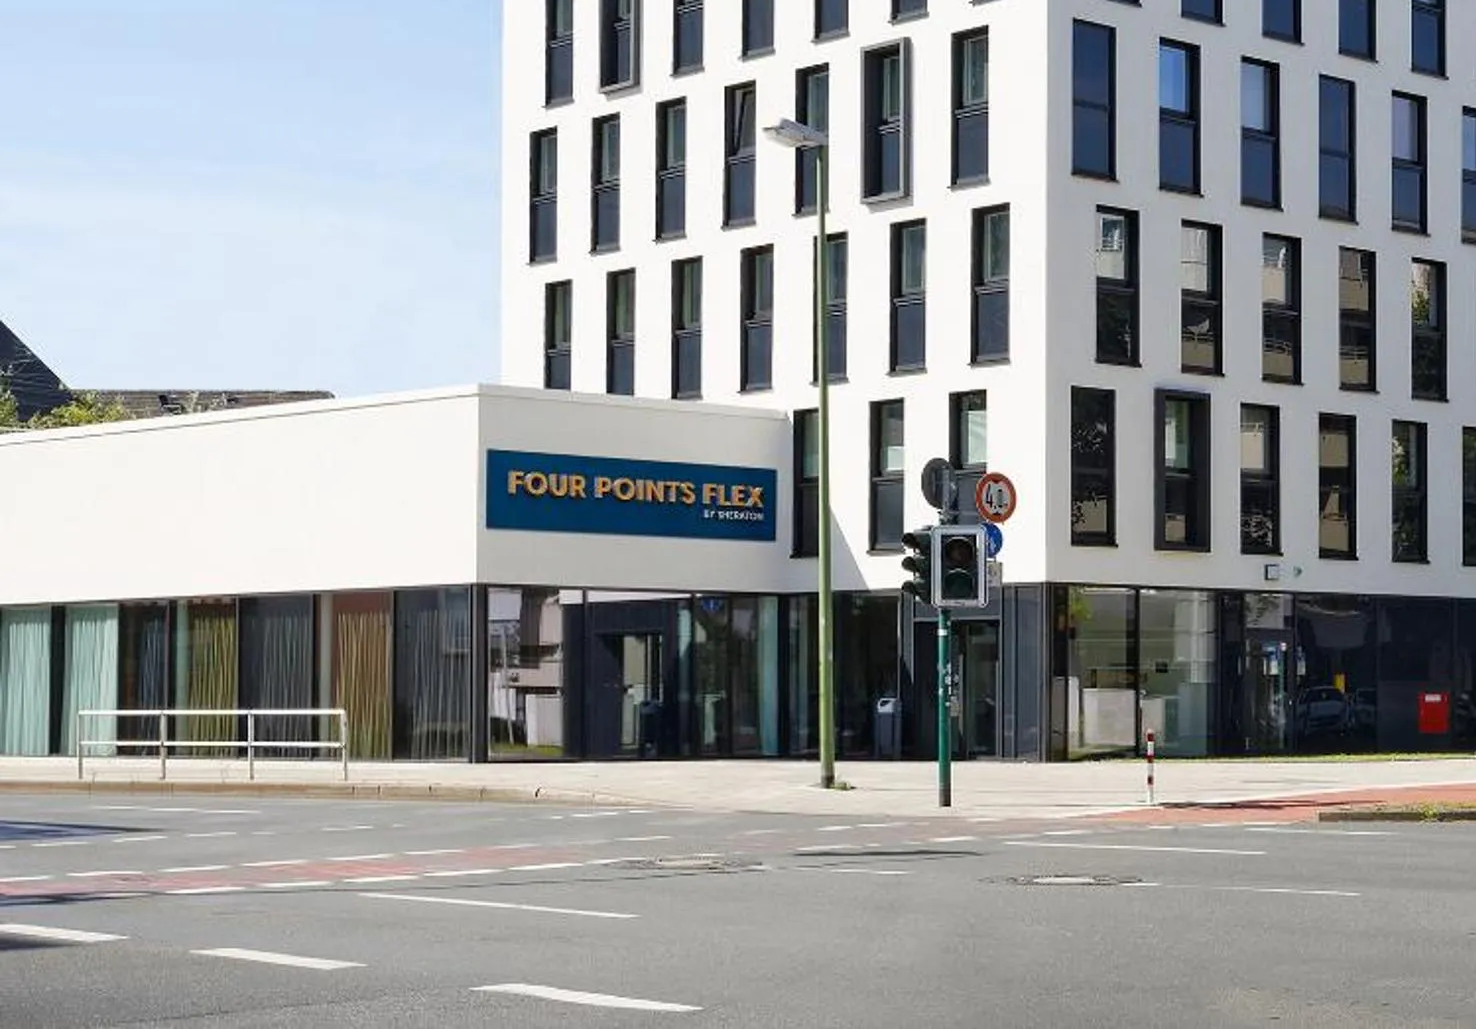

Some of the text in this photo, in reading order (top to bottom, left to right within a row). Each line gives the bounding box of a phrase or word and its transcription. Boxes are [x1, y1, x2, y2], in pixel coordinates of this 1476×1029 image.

[507, 470, 764, 508] FOUR POINTS FLEX
